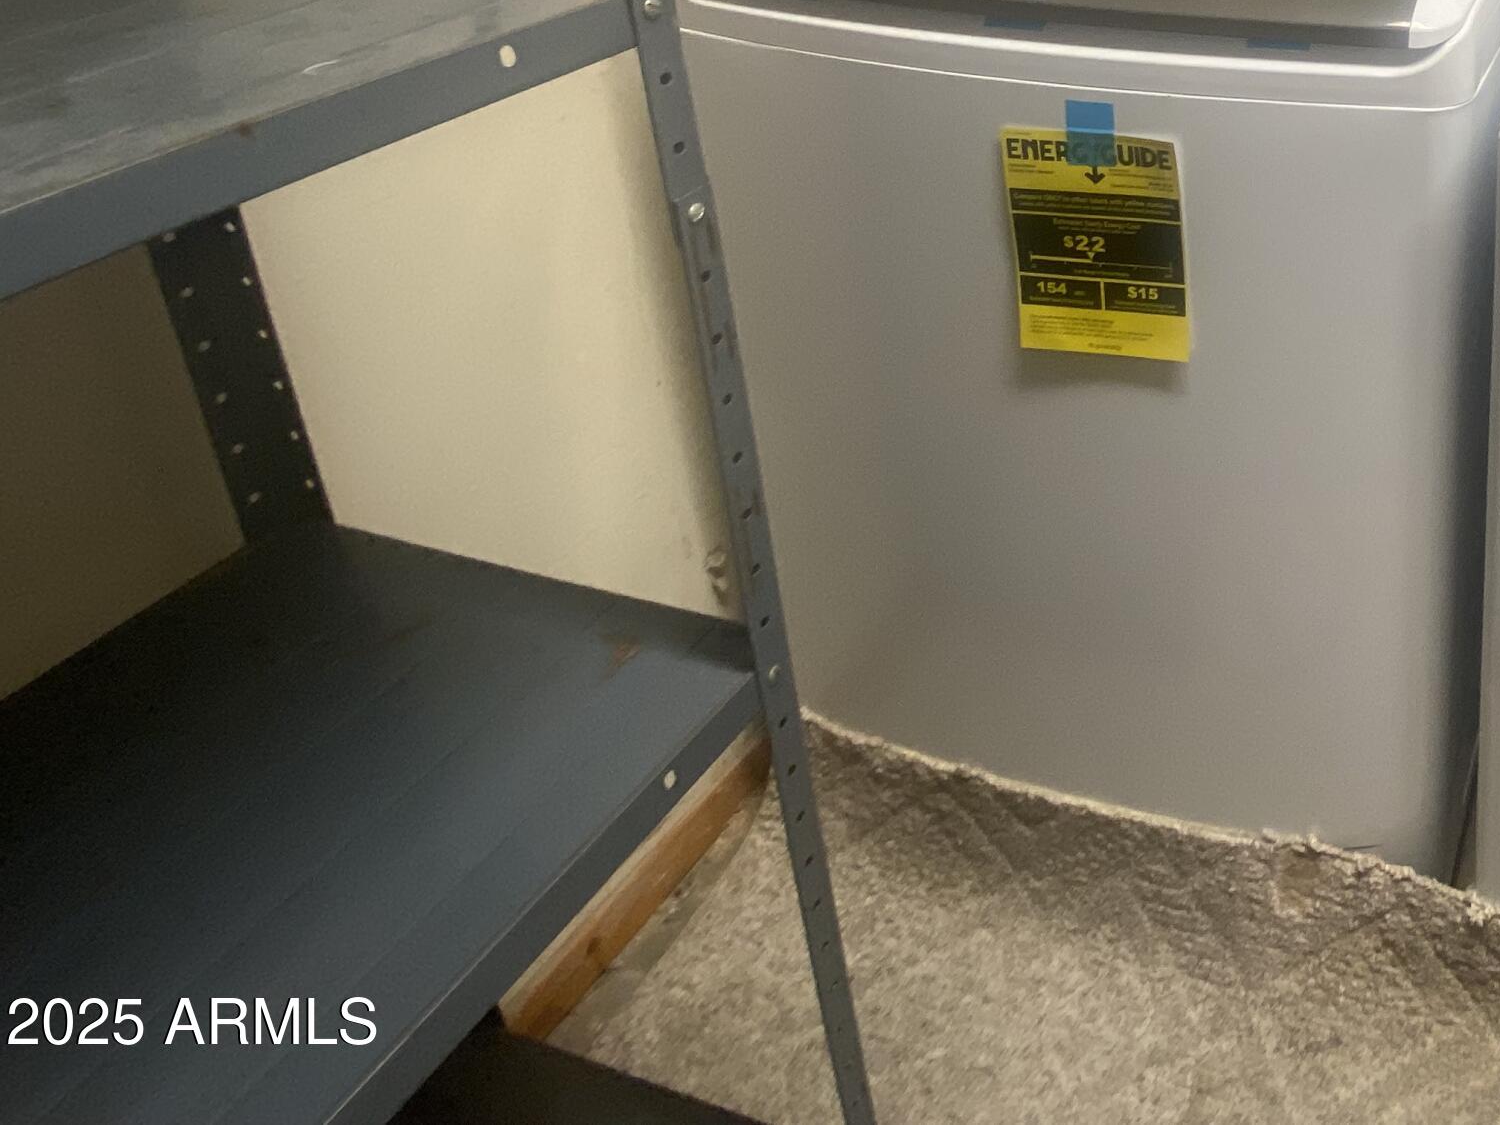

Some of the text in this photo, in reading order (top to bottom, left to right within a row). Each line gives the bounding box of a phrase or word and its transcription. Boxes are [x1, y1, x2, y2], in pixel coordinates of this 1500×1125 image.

[1063, 234, 1106, 253] $22
[1036, 281, 1067, 295] 154
[1127, 286, 1159, 300] $15
